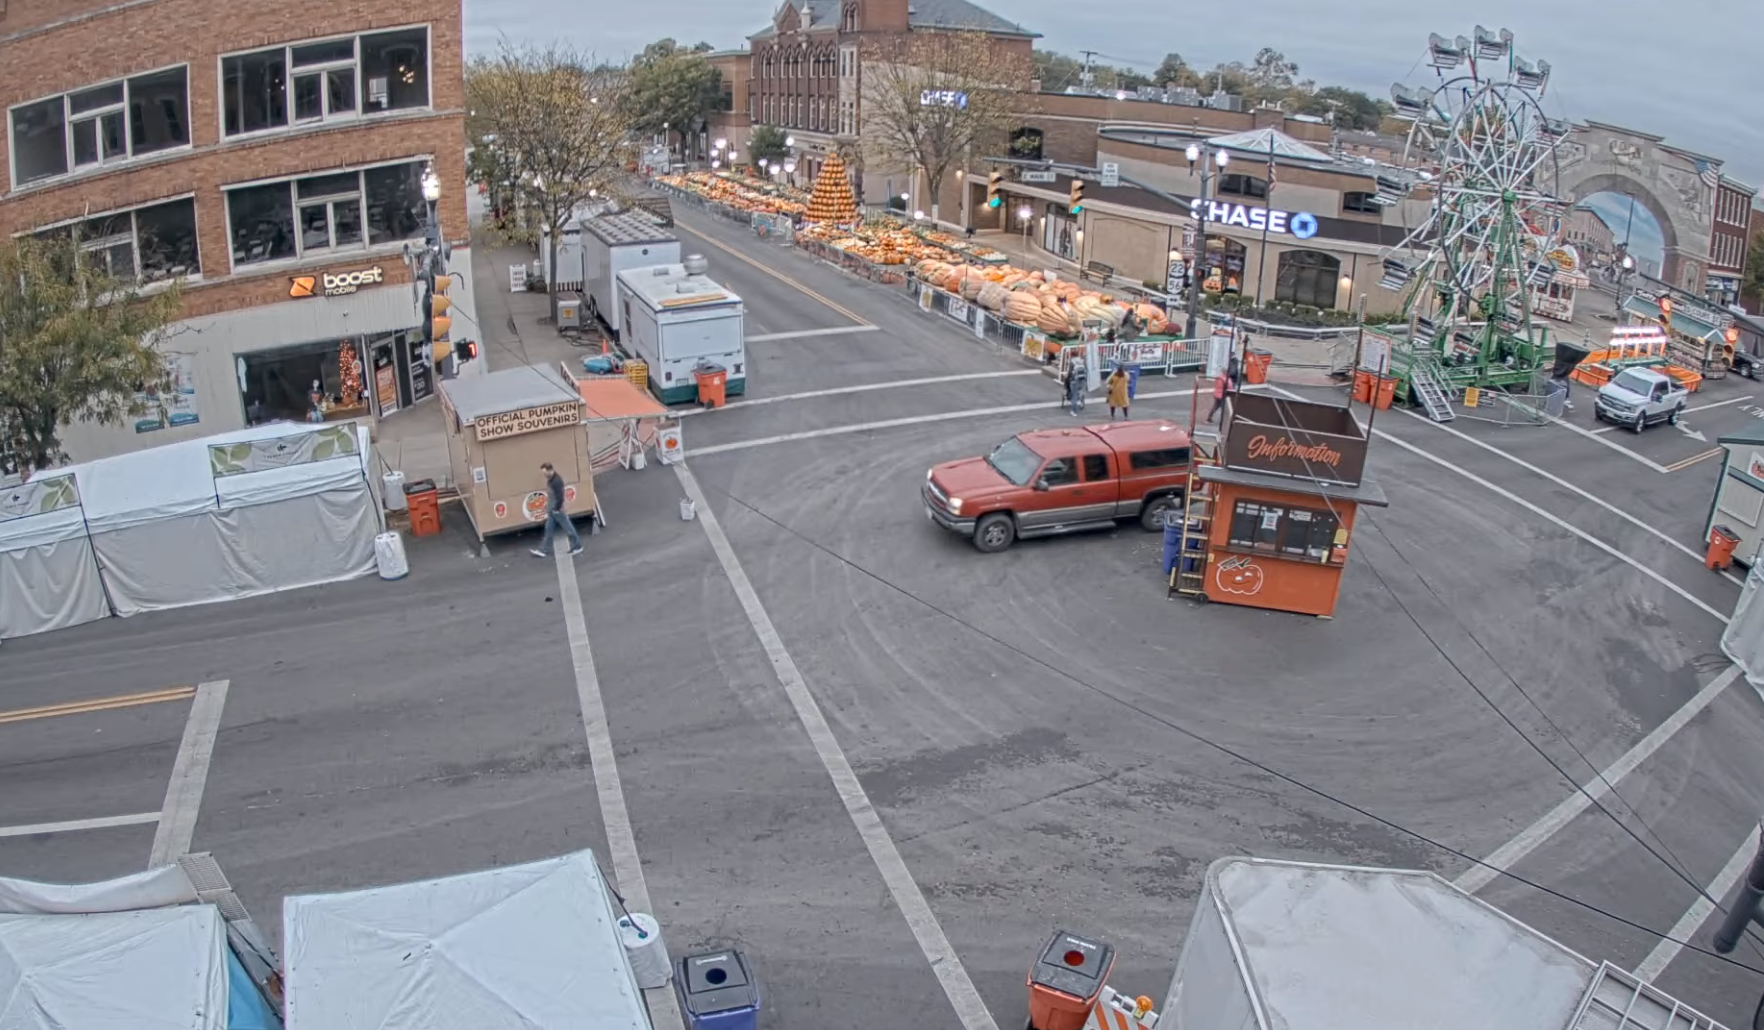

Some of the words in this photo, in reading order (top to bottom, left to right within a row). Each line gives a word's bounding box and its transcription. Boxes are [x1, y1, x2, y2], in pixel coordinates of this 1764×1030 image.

[1190, 199, 1288, 233] CHASE
[323, 266, 382, 288] boost
[1171, 263, 1184, 274] 22
[325, 286, 357, 296] mobile
[1169, 280, 1181, 290] 56
[478, 408, 525, 428] OFFICIAL
[529, 402, 577, 419] PUMPKIN
[480, 423, 514, 438] SHOW
[517, 412, 578, 431] SOUVENIRS
[1247, 435, 1341, 466] Information
